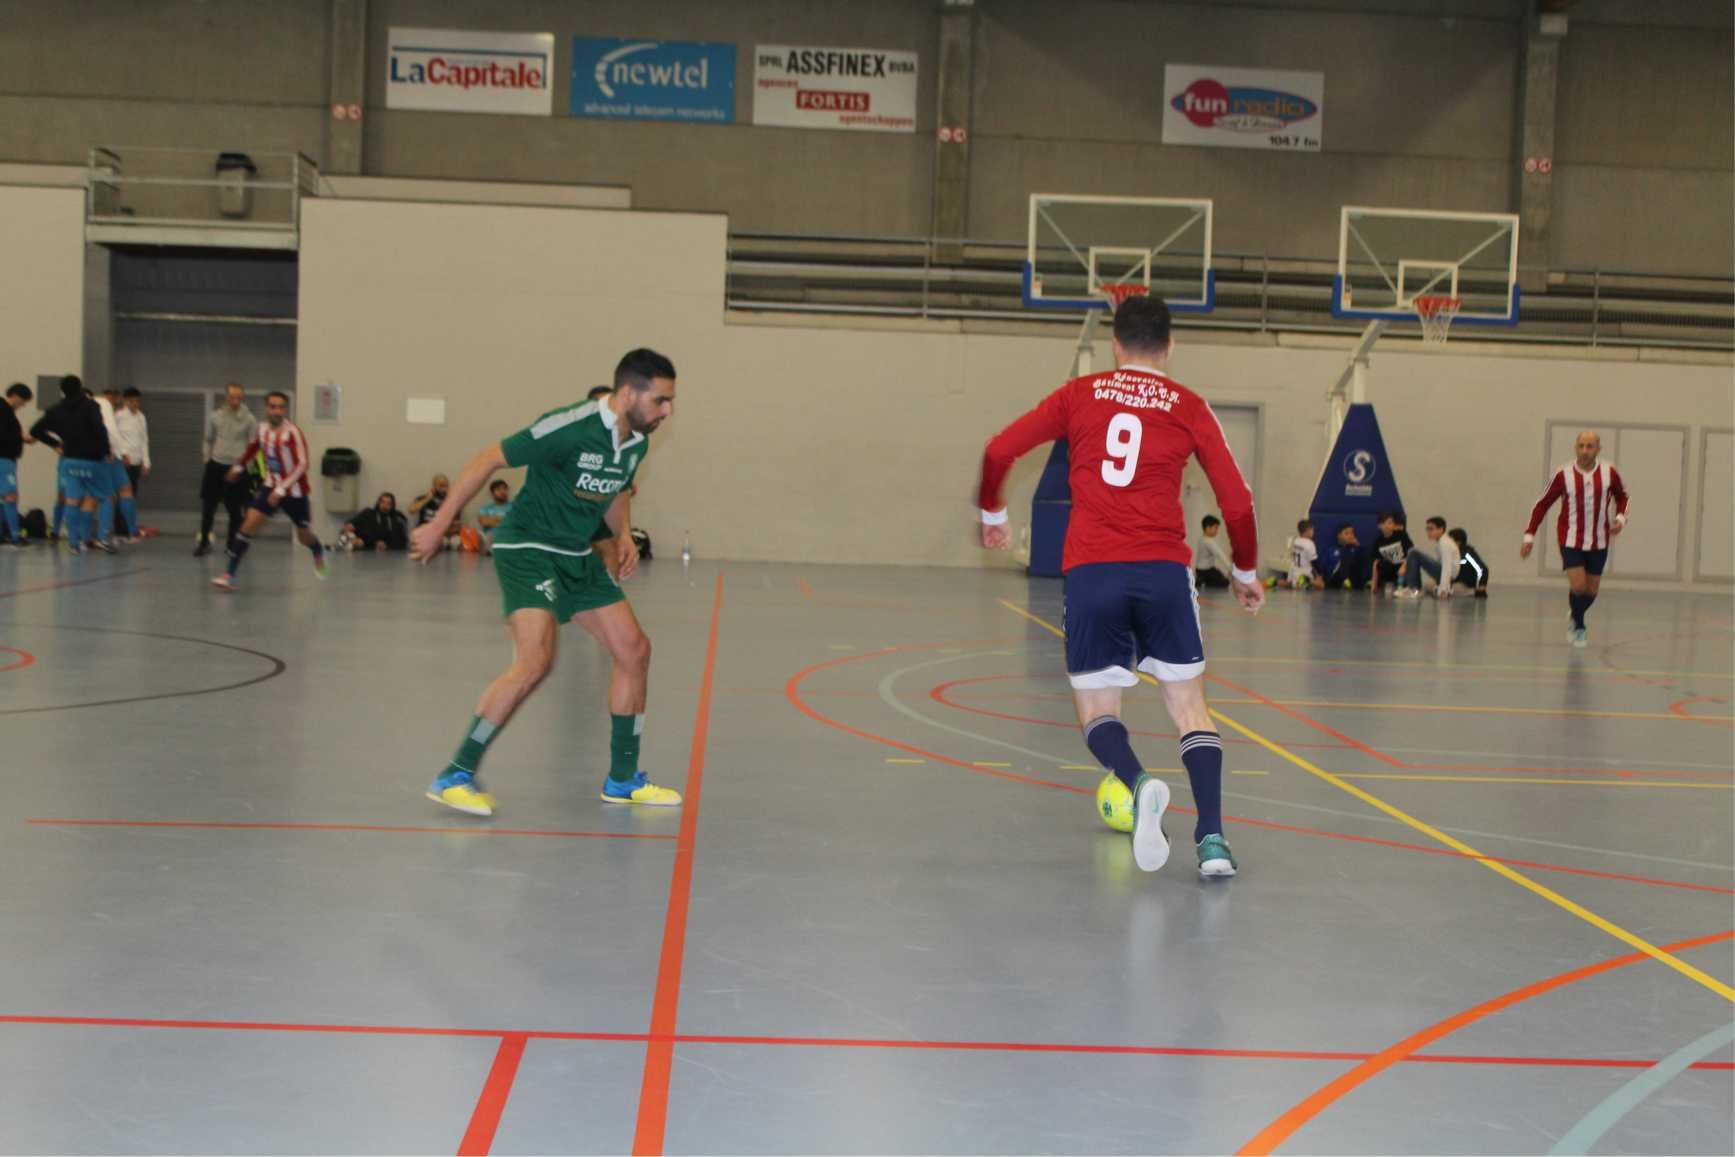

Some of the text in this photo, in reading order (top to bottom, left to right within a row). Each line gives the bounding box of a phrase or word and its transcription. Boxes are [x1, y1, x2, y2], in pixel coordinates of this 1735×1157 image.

[390, 56, 542, 89] LaCapitale
[612, 57, 709, 89] newtel
[786, 50, 886, 78] ASSFINEX
[800, 93, 865, 110] FORTIS
[1184, 92, 1228, 113] fun
[1101, 412, 1143, 488] 9
